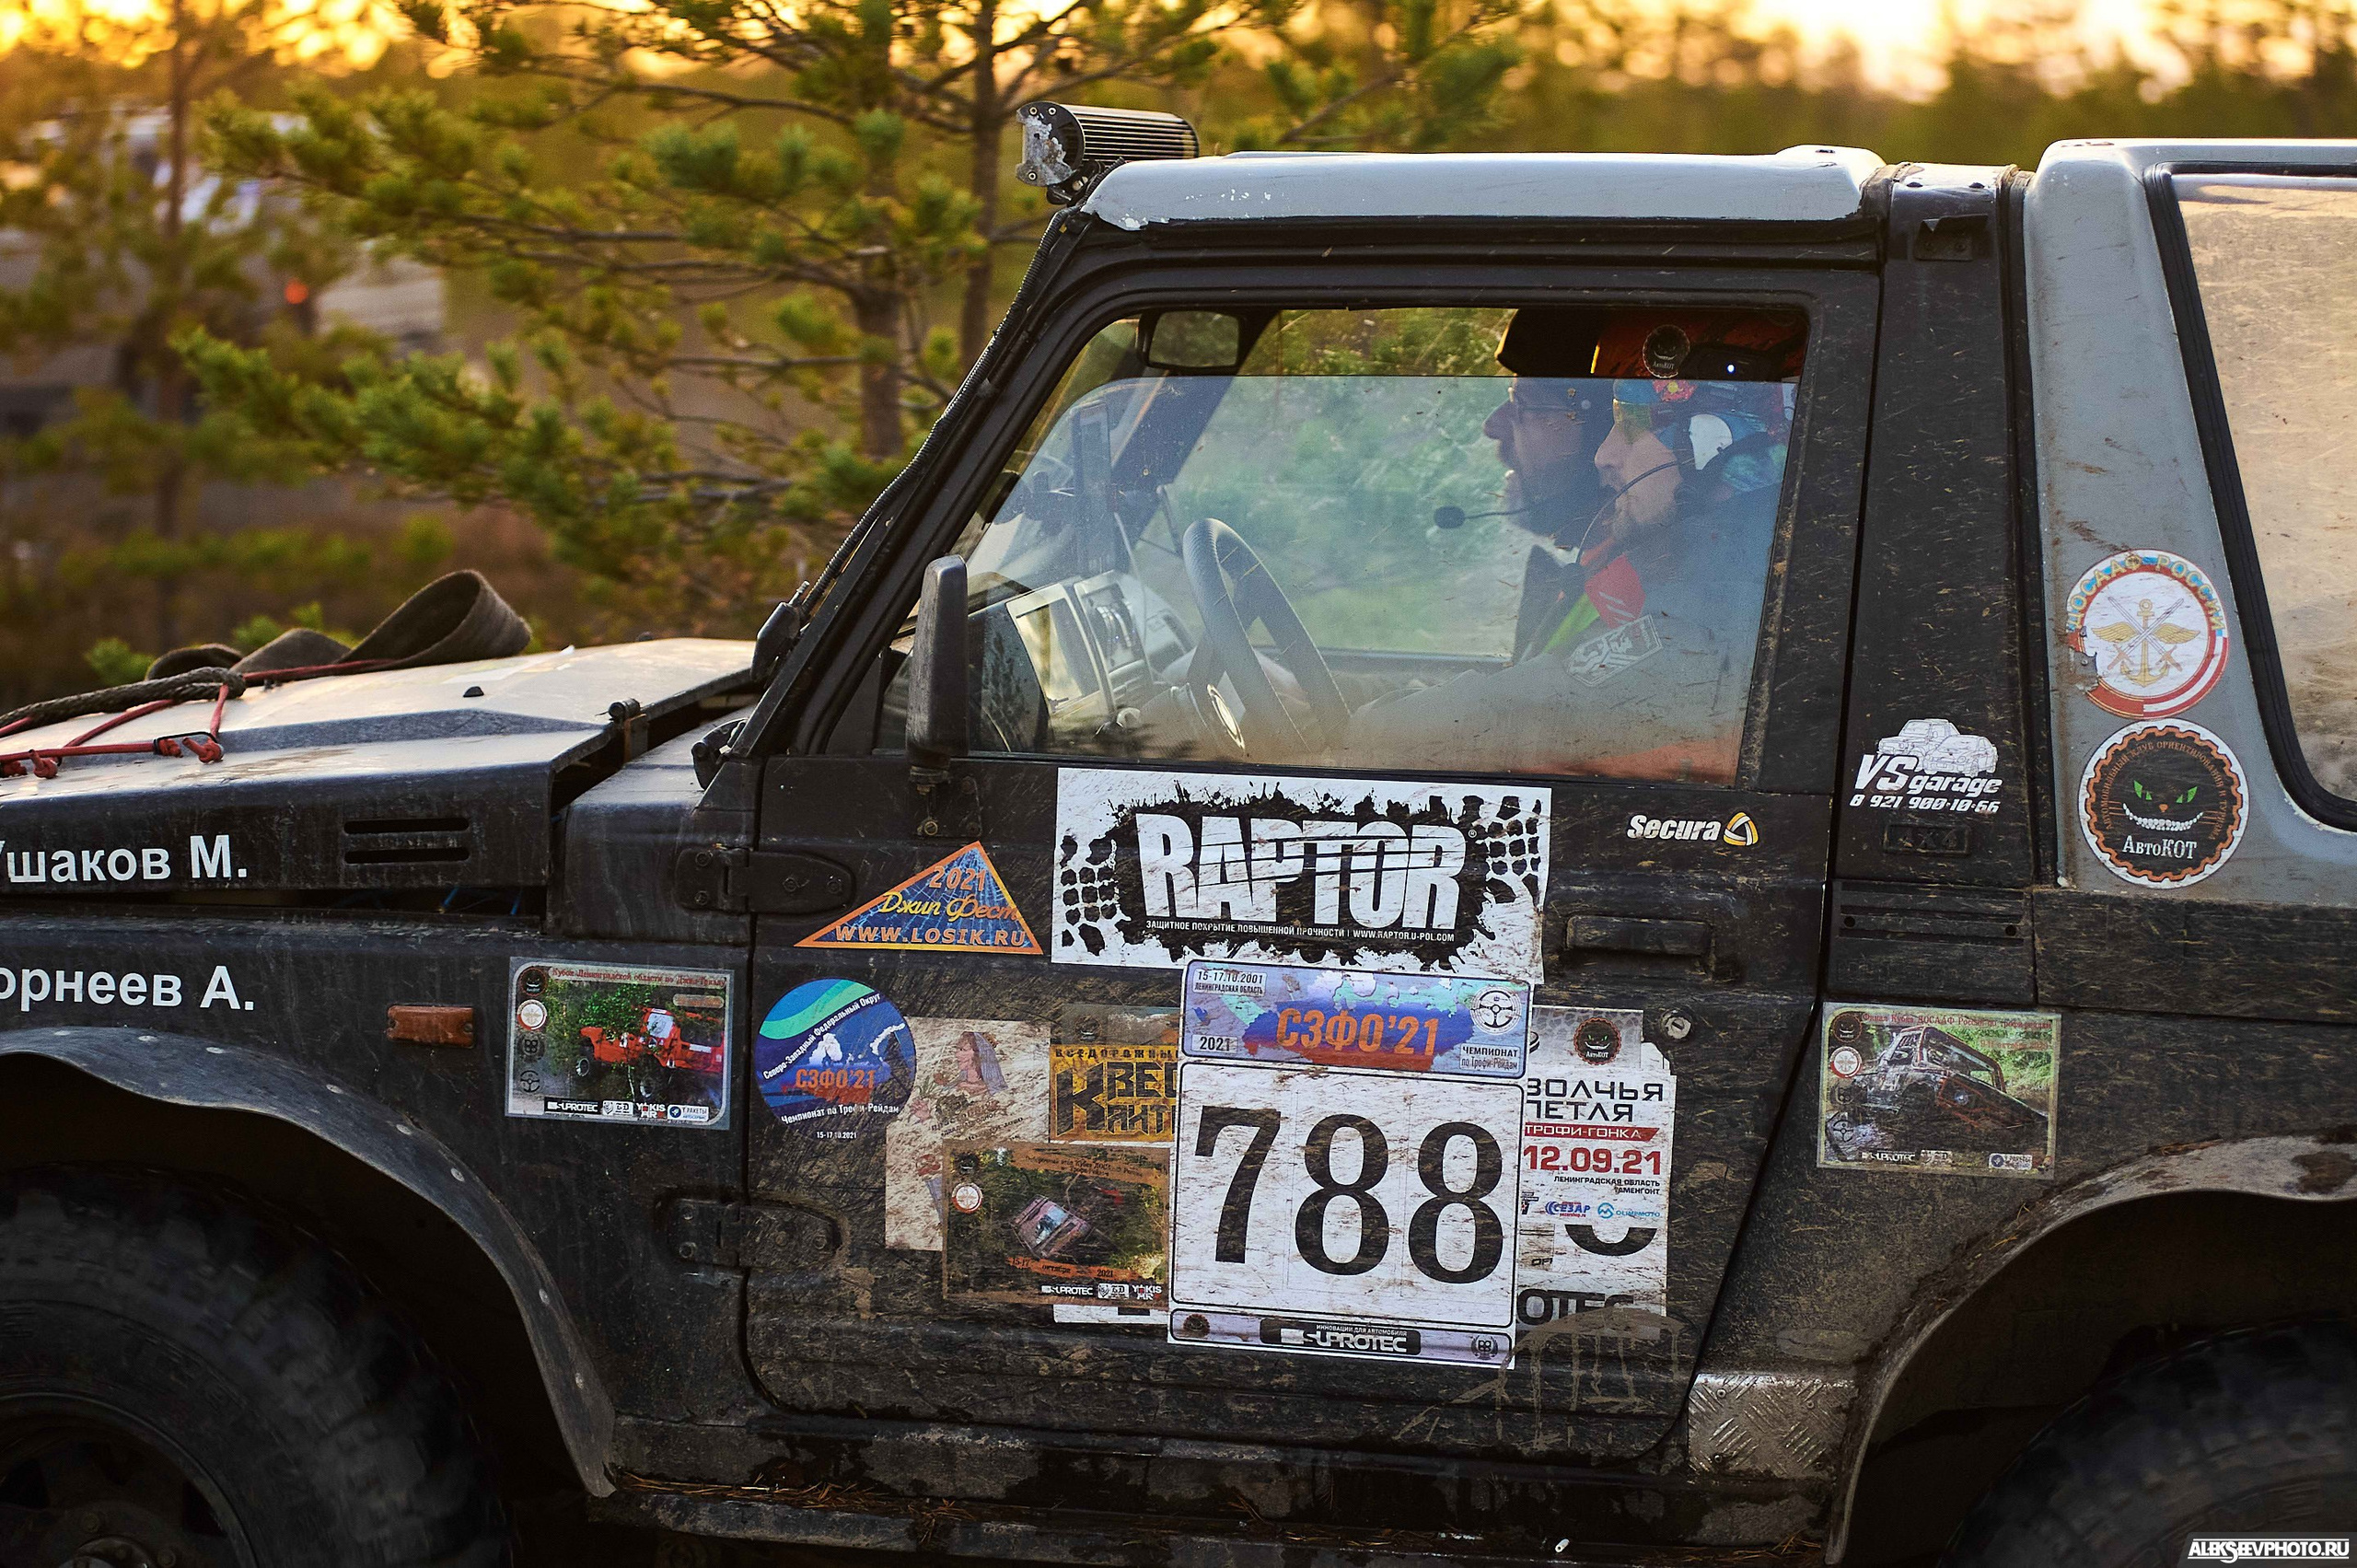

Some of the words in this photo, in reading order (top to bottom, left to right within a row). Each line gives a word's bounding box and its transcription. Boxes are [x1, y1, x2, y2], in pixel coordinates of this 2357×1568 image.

[2068, 553, 2143, 630] ДОСААФ
[2155, 554, 2224, 631] РОССИИ
[1850, 795, 1865, 807] 8
[1870, 796, 1904, 808] 921
[1627, 815, 1721, 842] Secura
[0, 840, 171, 883] шаков
[190, 834, 249, 880] М.
[928, 865, 985, 891] 2021
[1135, 812, 1468, 930] RAPTOR
[835, 925, 1026, 947] WWW.LOSIK.RU
[1145, 921, 1190, 931] ЗАЩИТНОЕ
[1191, 923, 1236, 933] ПОКРЫТИЕ
[1237, 924, 1295, 935] ПОВЫШЕННОЙ
[1296, 927, 1345, 938] ПРОЧНОСТИ
[1198, 971, 1263, 984] 15-17.10.2001
[200, 965, 254, 1011] А.
[1194, 982, 1238, 993] ЛЕНИНГРАДСКАЯ
[1239, 984, 1263, 994] ОБЛАСТЬ
[1918, 1016, 1955, 1026] ДОСААФ
[762, 1034, 817, 1080] Северо-Западный
[814, 1002, 860, 1037] Федеральный
[859, 993, 881, 1007] Округ
[1276, 1006, 1440, 1057] СЗФО'21
[1200, 1036, 1230, 1051] 2021
[1462, 1046, 1518, 1057] ЧЕМПИОНАТ
[557, 1101, 598, 1113] SUPROTEC
[782, 1109, 825, 1125] Чемпионат
[827, 1106, 837, 1115] по
[1525, 1124, 1643, 1140] ТРОФИ-ГОНКА
[1524, 1145, 1662, 1176] 12.09.21
[1554, 1175, 1622, 1186] ЛЕНИНГРАДСКАЯ
[1623, 1179, 1661, 1187] ОБЛАСТЬ
[1194, 1105, 1504, 1284] 788
[1615, 1187, 1660, 1195] ТАМЕНГОНТ
[1552, 1203, 1591, 1214] СЕЗАР
[1616, 1210, 1661, 1218] OLIMPMOTO
[1097, 1269, 1114, 1278] 2021
[1316, 1323, 1353, 1333] ИННОВАЦИИ
[1367, 1328, 1408, 1337] АВТОМОБИЛЯ
[1303, 1330, 1408, 1353] SUPROTEC
